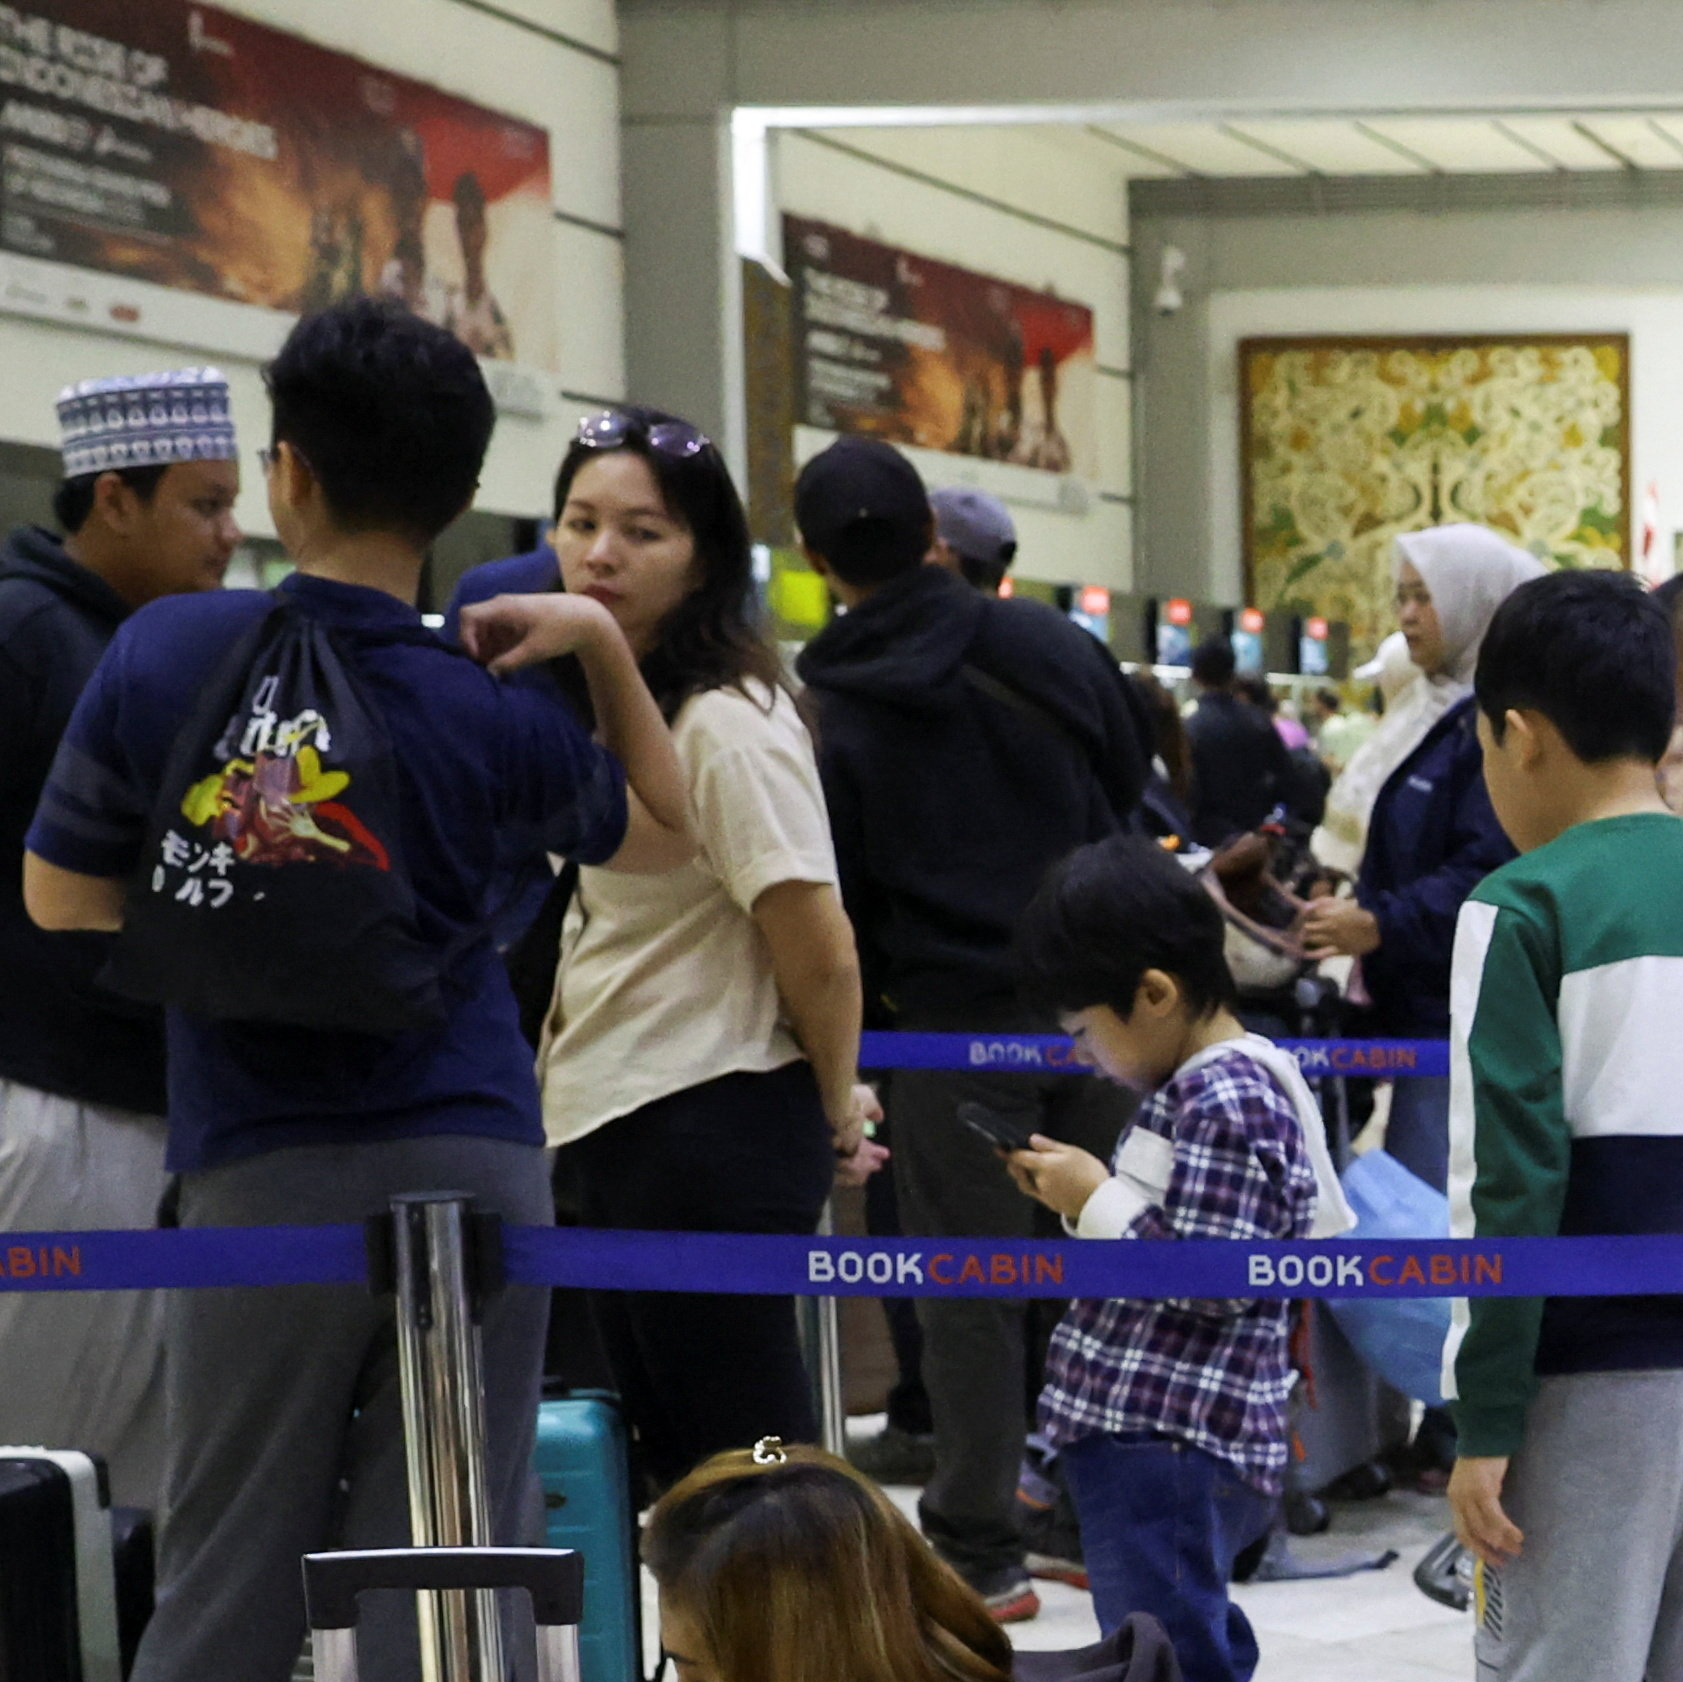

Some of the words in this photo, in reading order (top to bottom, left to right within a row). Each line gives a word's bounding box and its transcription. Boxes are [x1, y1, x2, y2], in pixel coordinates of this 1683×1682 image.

[1294, 1046, 1415, 1069] OKCABIN
[0, 1247, 81, 1278] BIN
[808, 1250, 1064, 1286] BOOKCABIN
[1248, 1254, 1503, 1286] BOOKCABIN
